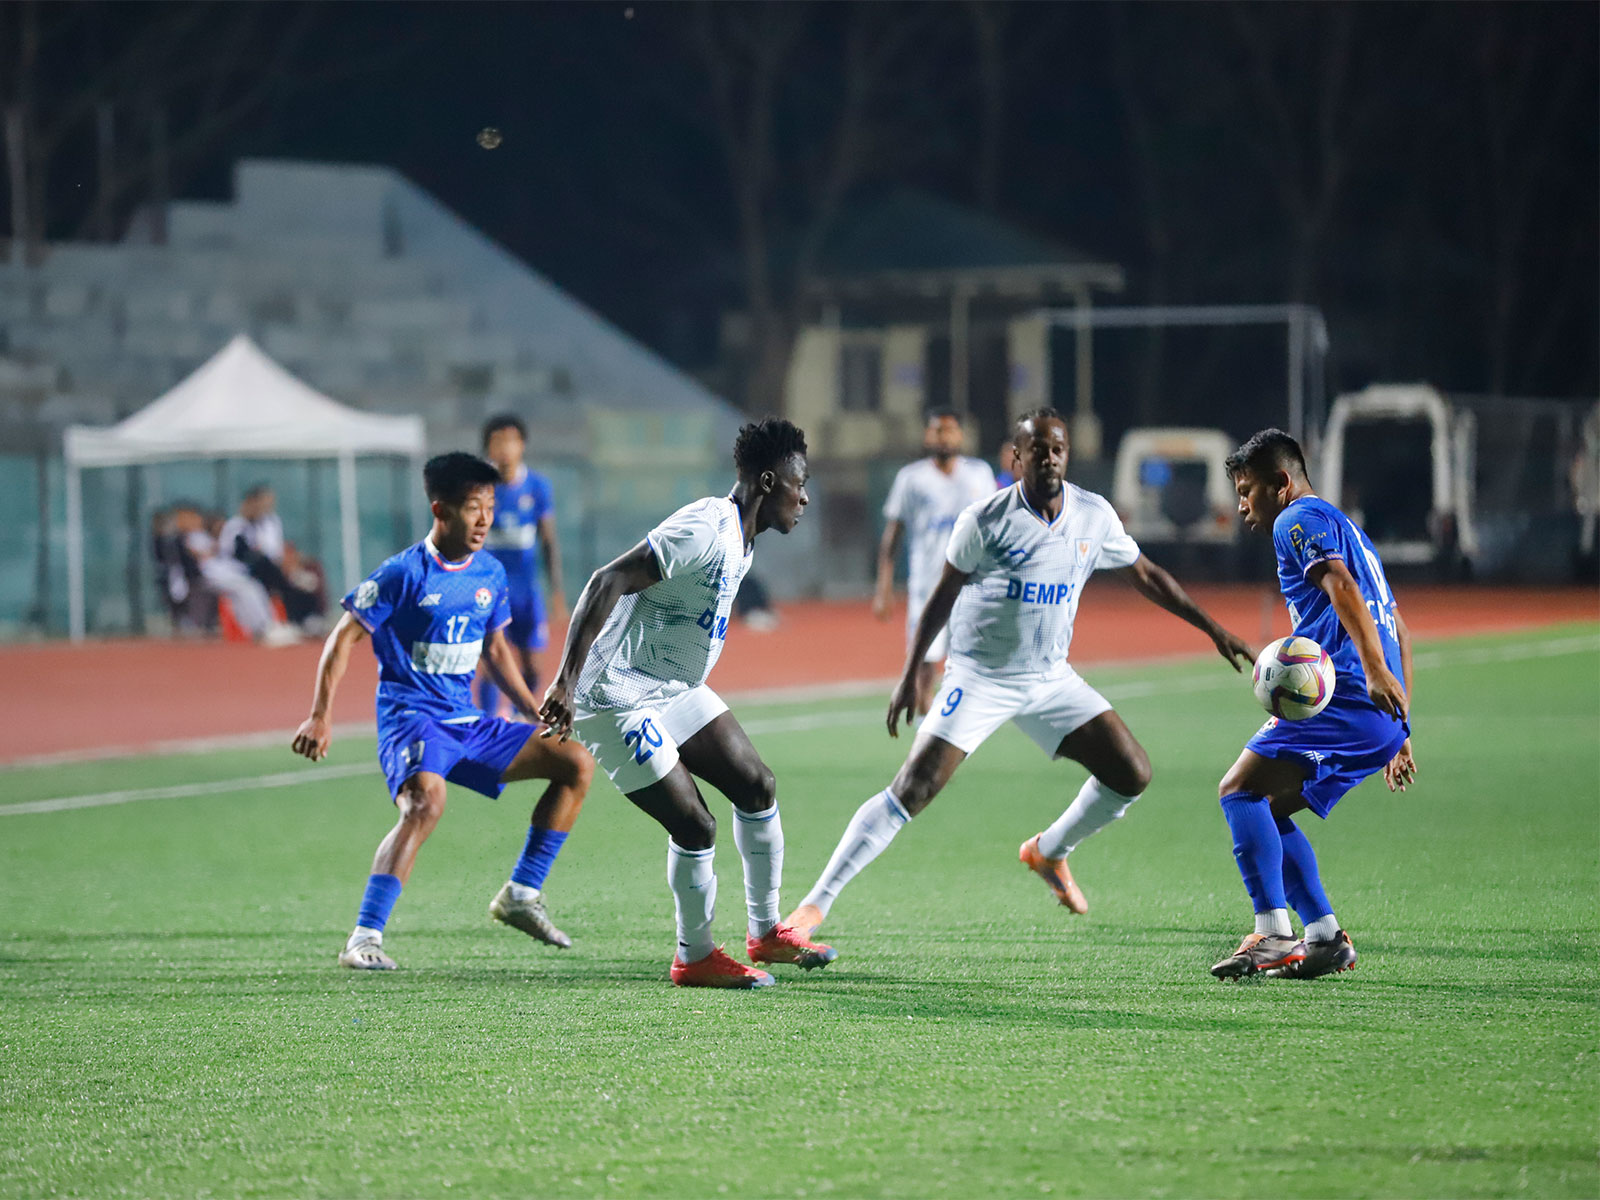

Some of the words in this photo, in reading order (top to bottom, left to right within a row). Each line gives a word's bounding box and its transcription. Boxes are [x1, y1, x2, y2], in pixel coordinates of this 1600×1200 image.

[447, 615, 470, 643] 17
[941, 688, 963, 716] 9
[625, 717, 663, 766] 20
